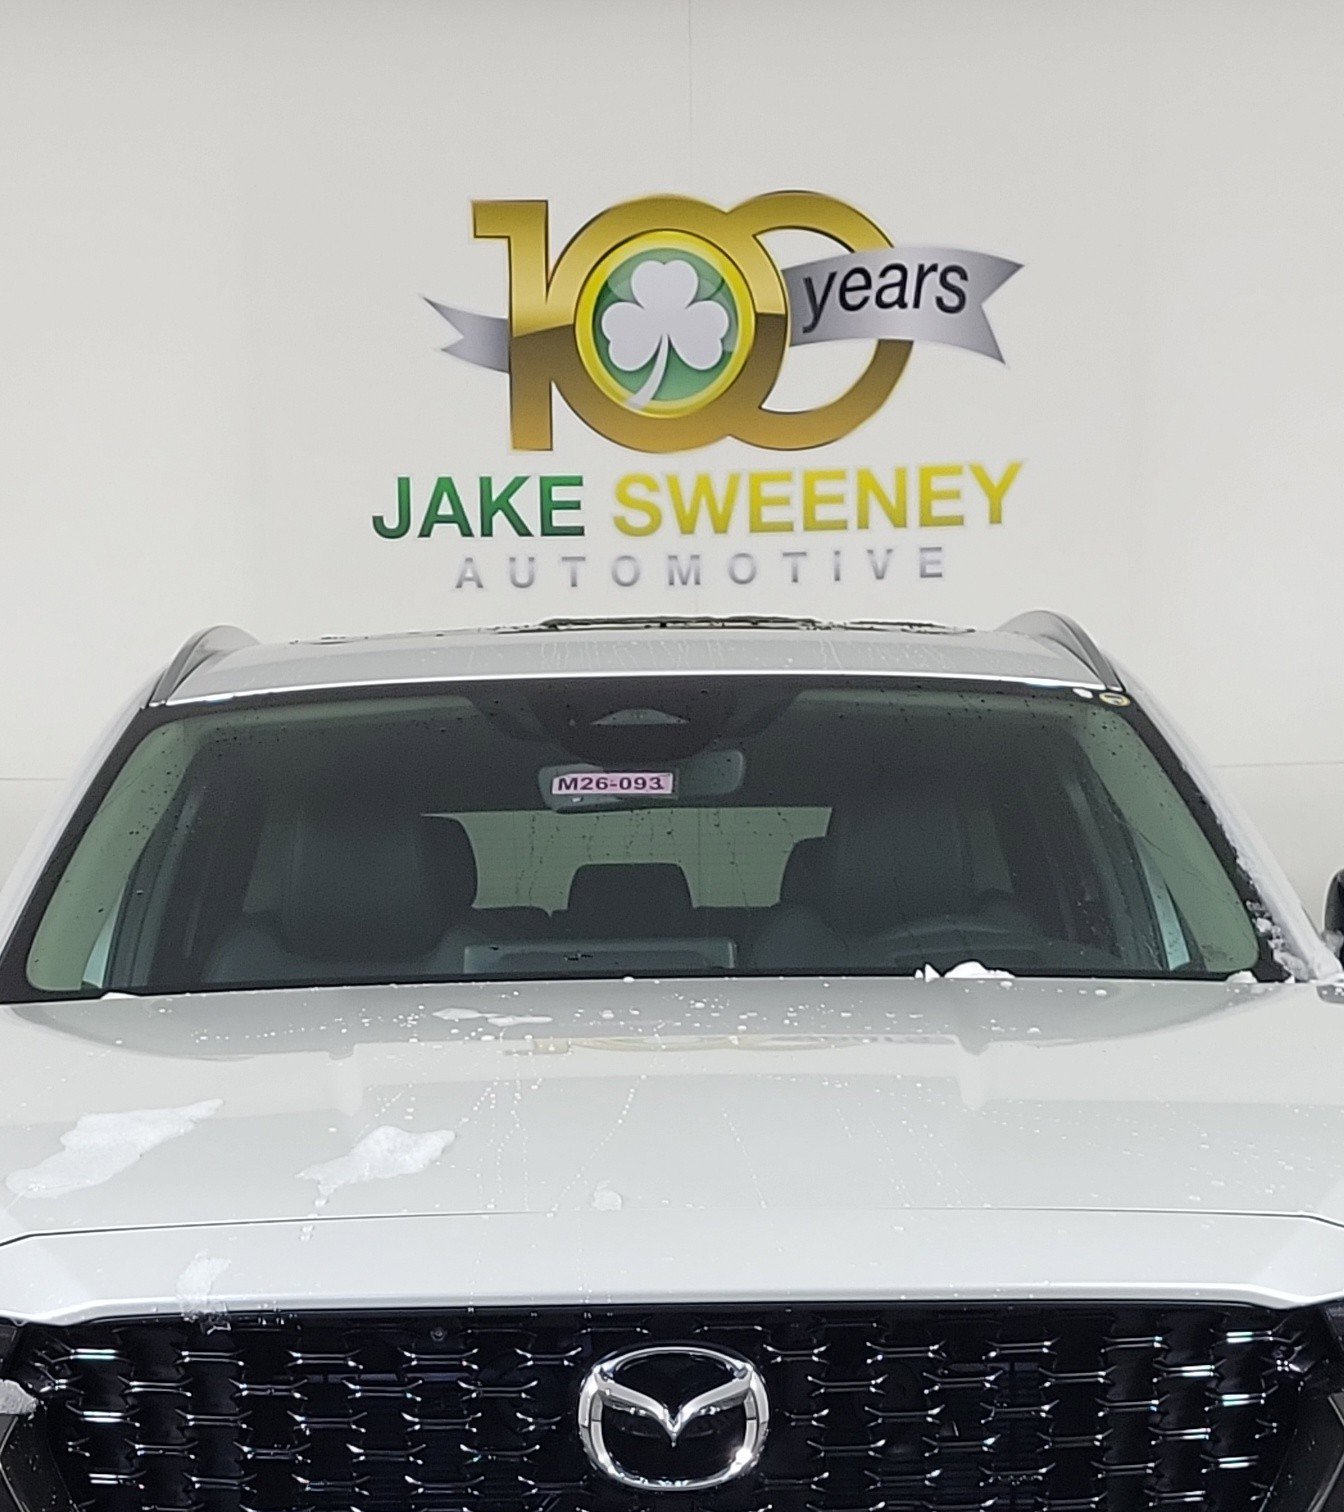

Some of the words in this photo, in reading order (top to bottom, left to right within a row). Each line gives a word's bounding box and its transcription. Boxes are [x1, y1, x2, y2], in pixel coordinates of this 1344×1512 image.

[471, 189, 914, 454] 100
[801, 260, 969, 334] years
[372, 475, 586, 540] JAKE
[612, 462, 1023, 538] SWEENEY
[454, 547, 945, 590] AUTOMOTIVE
[557, 776, 665, 791] M26-093
